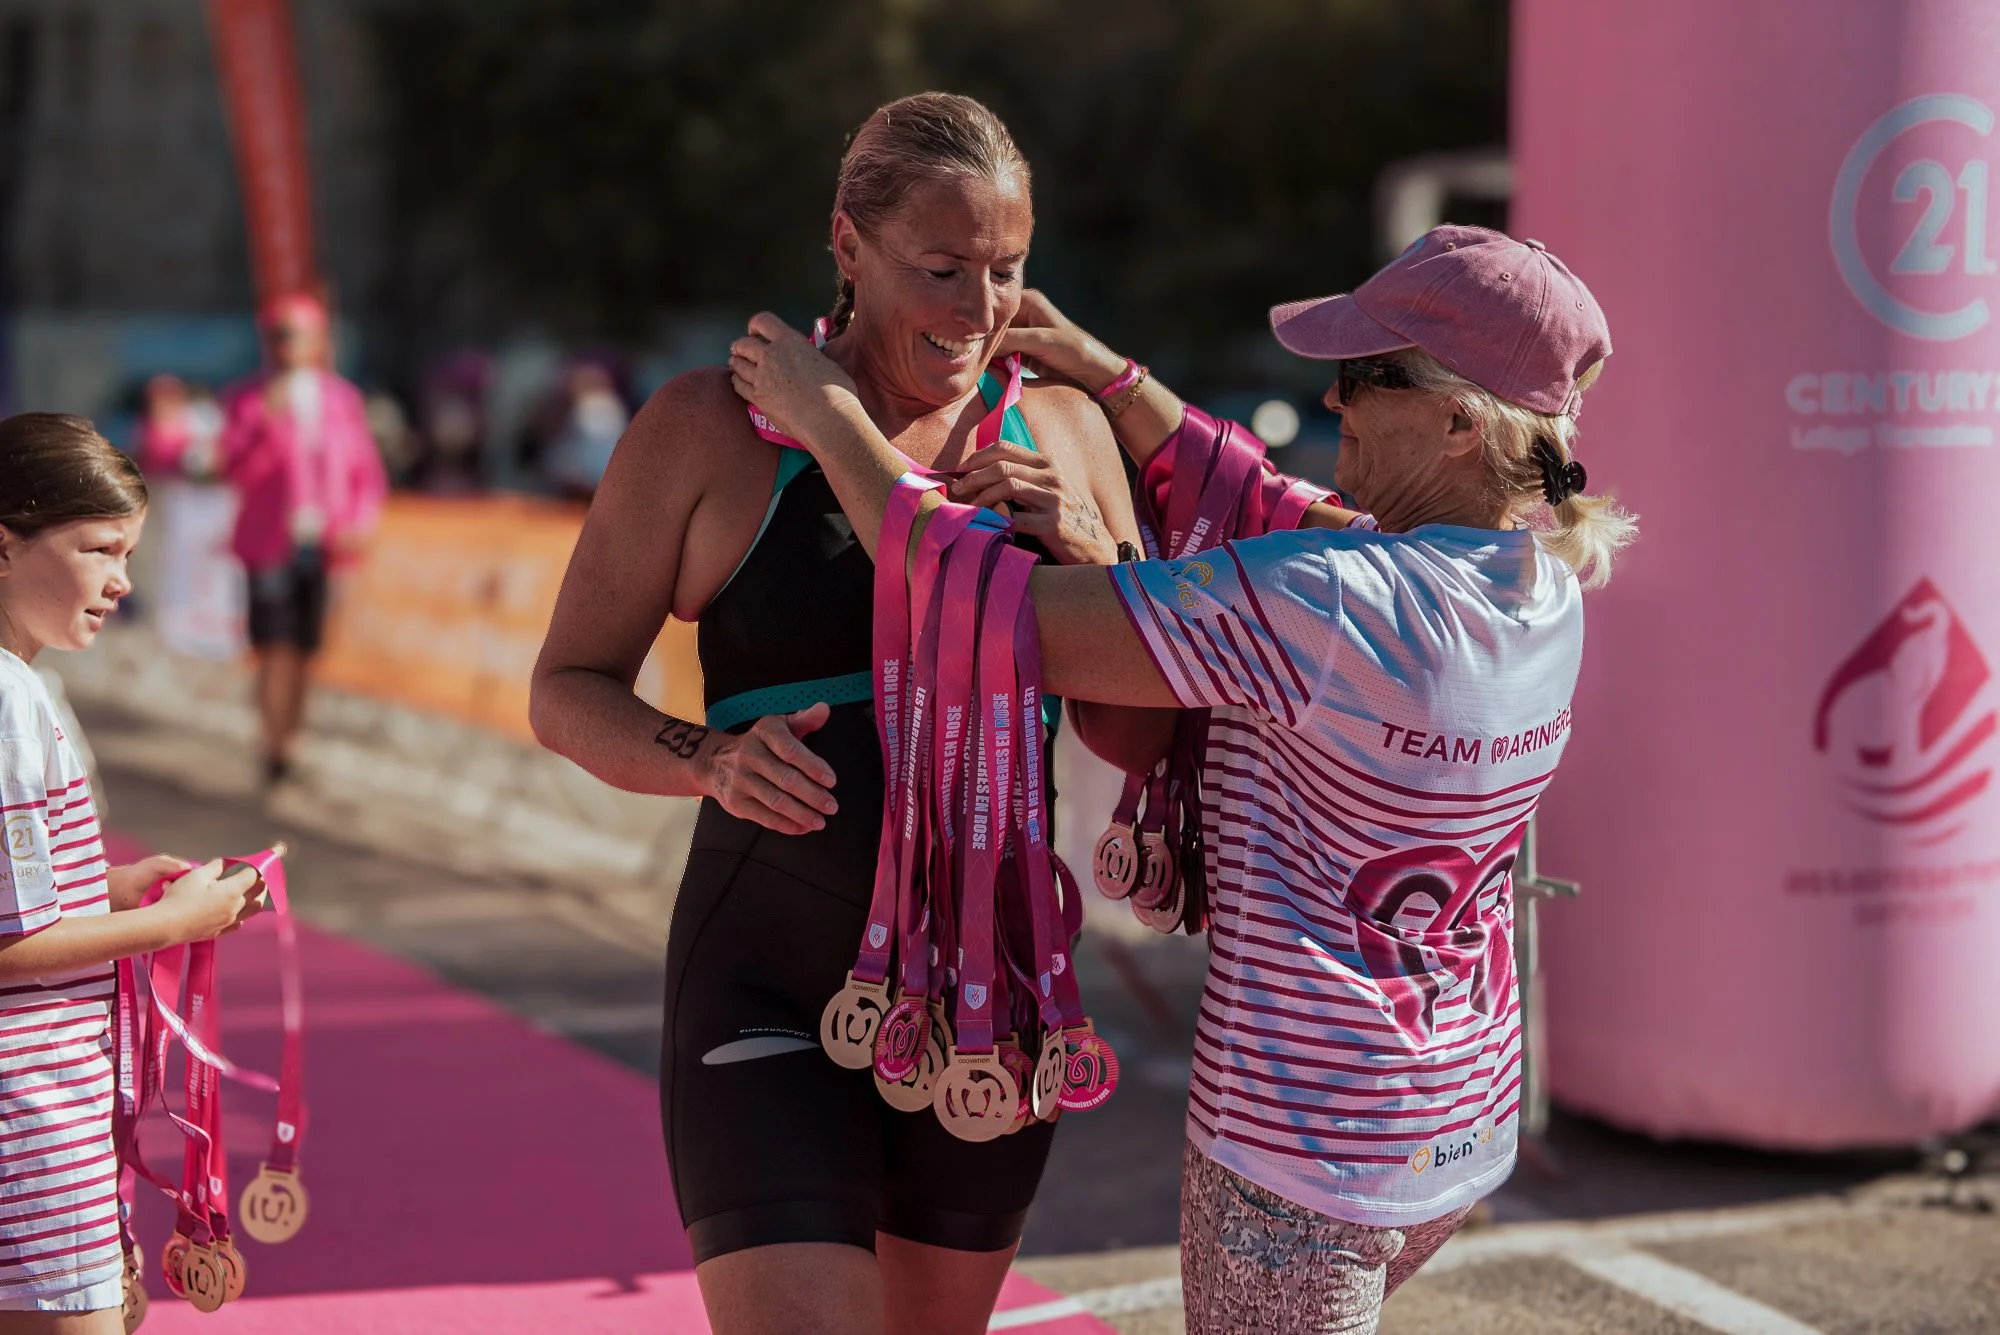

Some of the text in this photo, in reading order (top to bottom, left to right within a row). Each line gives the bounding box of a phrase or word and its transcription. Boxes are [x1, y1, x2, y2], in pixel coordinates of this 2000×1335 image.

[1890, 159, 1998, 275] 21
[1786, 370, 1992, 415] CENTURY
[1193, 517, 1212, 536] LES
[883, 658, 900, 693] ROSE
[884, 694, 898, 711] EN
[914, 686, 927, 707] LES
[993, 693, 1010, 728] ROSE
[945, 705, 962, 739] ROSE
[996, 730, 1011, 747] EN
[944, 741, 958, 758] EN
[1381, 722, 1482, 765] TEAM
[1023, 686, 1041, 844] LES MARINIÈRES EN ROSE
[974, 795, 990, 813] EN
[10, 826, 34, 849] 21
[972, 814, 988, 850] ROSE
